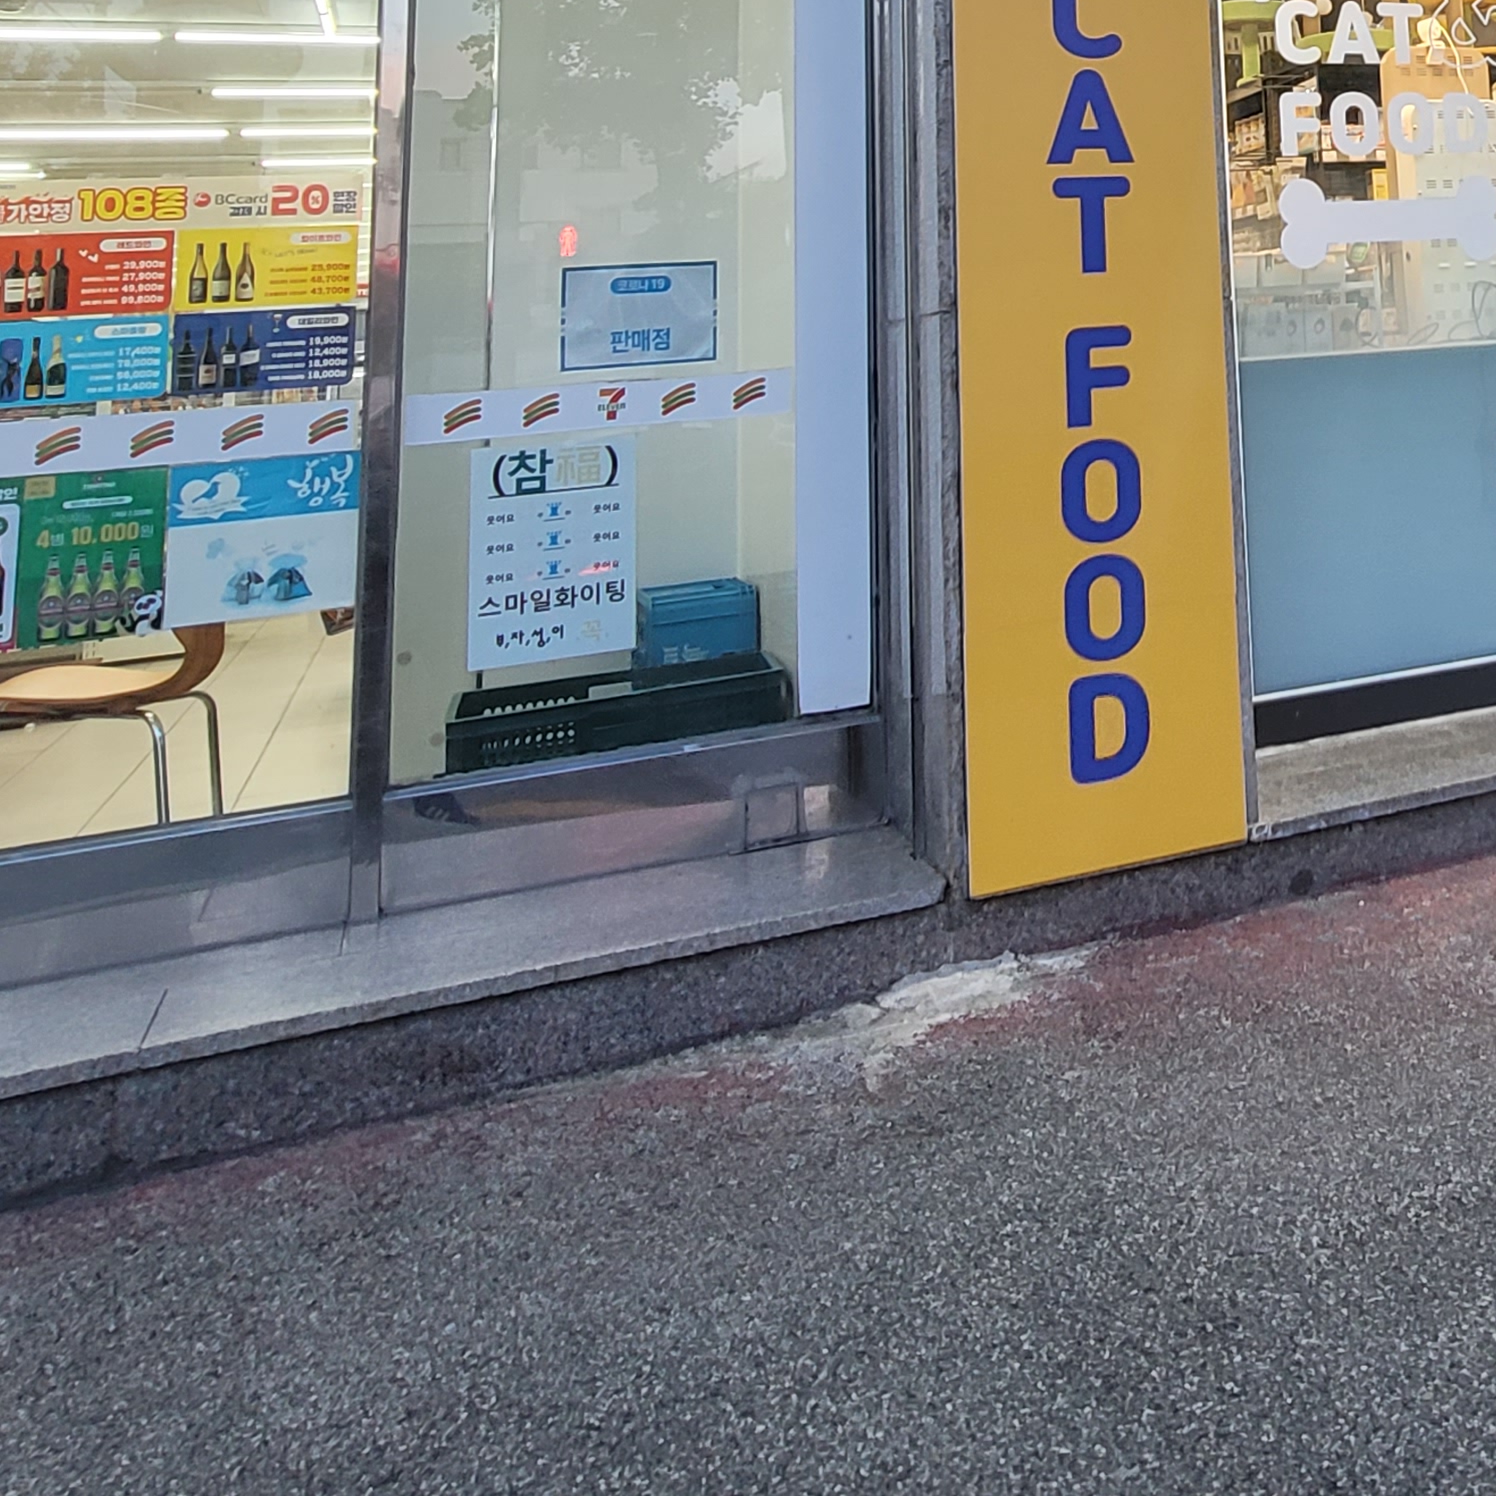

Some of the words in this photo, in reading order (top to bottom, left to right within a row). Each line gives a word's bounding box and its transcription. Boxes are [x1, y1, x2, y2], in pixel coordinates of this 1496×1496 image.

[1275, 0, 1424, 65] CAT
[1280, 92, 1487, 157] FOOD
[78, 186, 188, 223] 108종
[214, 193, 269, 205] BCcard
[651, 278, 665, 290] 19
[609, 327, 671, 354] 판매점
[1061, 325, 1150, 784] FOOD
[477, 579, 626, 617] 스마일화이팅
